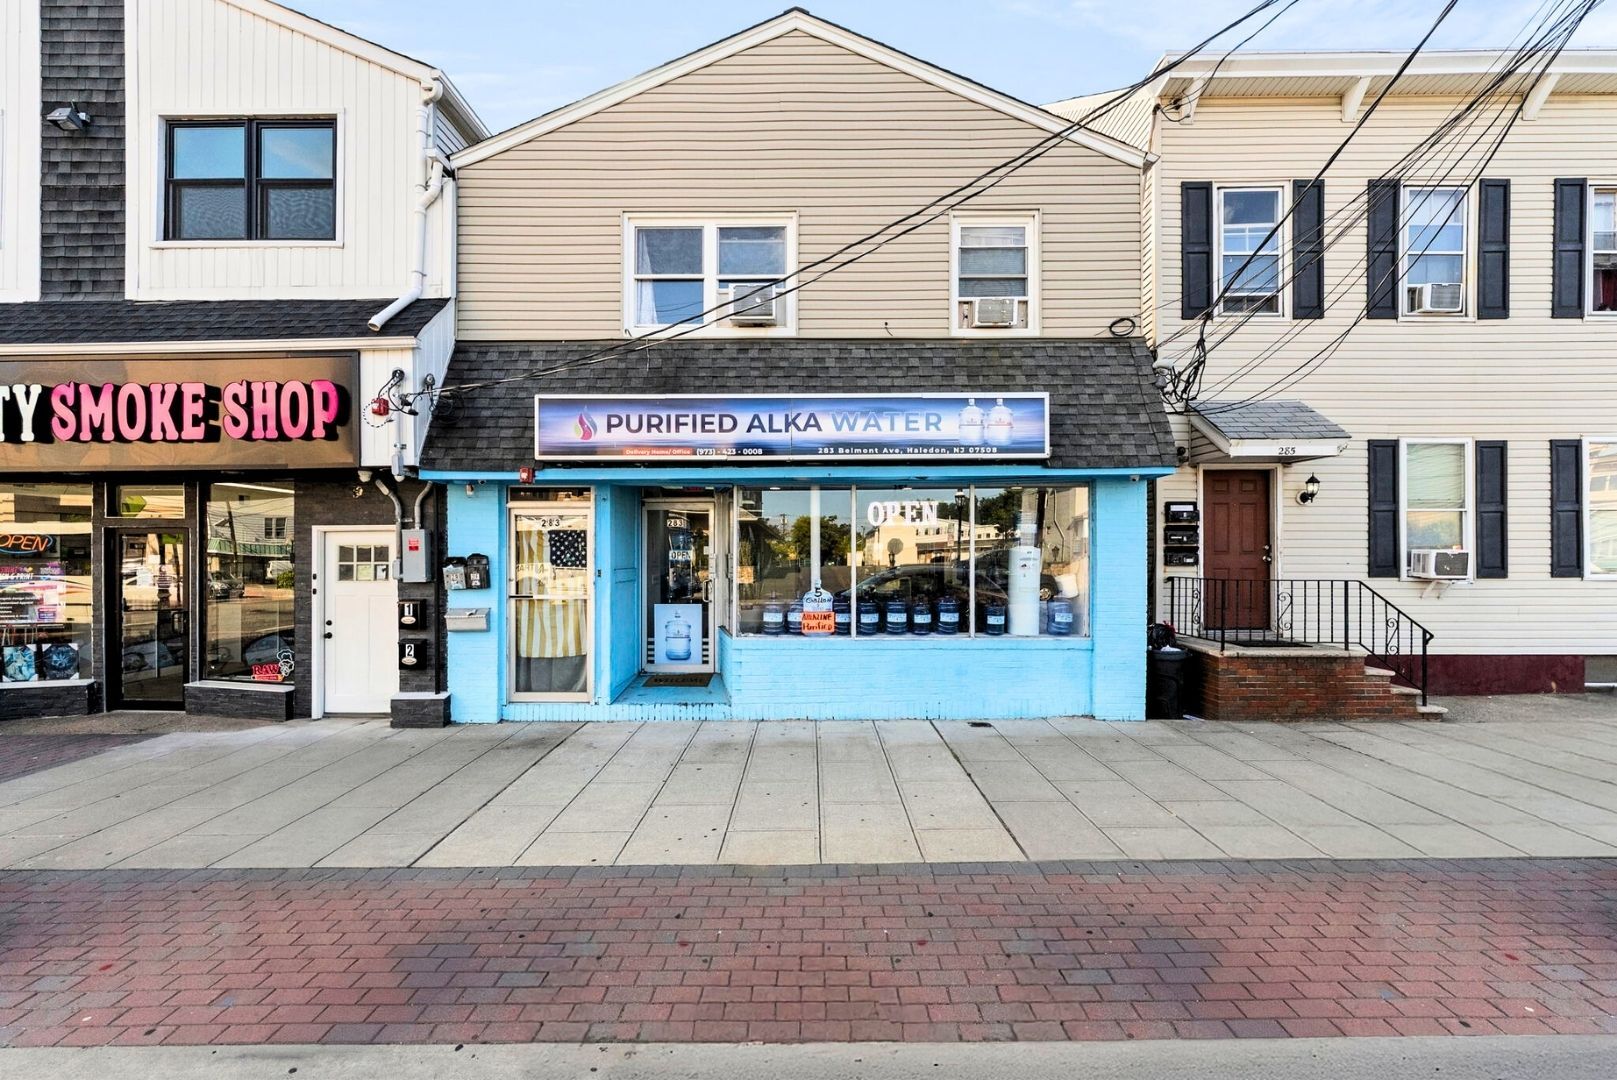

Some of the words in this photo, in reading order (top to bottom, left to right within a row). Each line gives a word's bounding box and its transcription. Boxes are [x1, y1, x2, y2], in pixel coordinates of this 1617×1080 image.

[51, 382, 206, 441] SMOKE
[222, 380, 339, 439] SHOP
[606, 413, 738, 434] PURIFIED
[746, 412, 823, 433] ALKA
[831, 412, 942, 432] WATER
[696, 448, 716, 456] (973)
[907, 447, 950, 455] Haledon,
[1278, 447, 1296, 455] 285
[868, 500, 938, 527] OPEN
[541, 519, 560, 527] 283
[667, 519, 683, 528] 283
[0, 534, 48, 551] OPEN
[814, 587, 823, 598] 5
[406, 604, 412, 616] 1
[406, 644, 413, 657] 2
[252, 663, 279, 675] RAW
